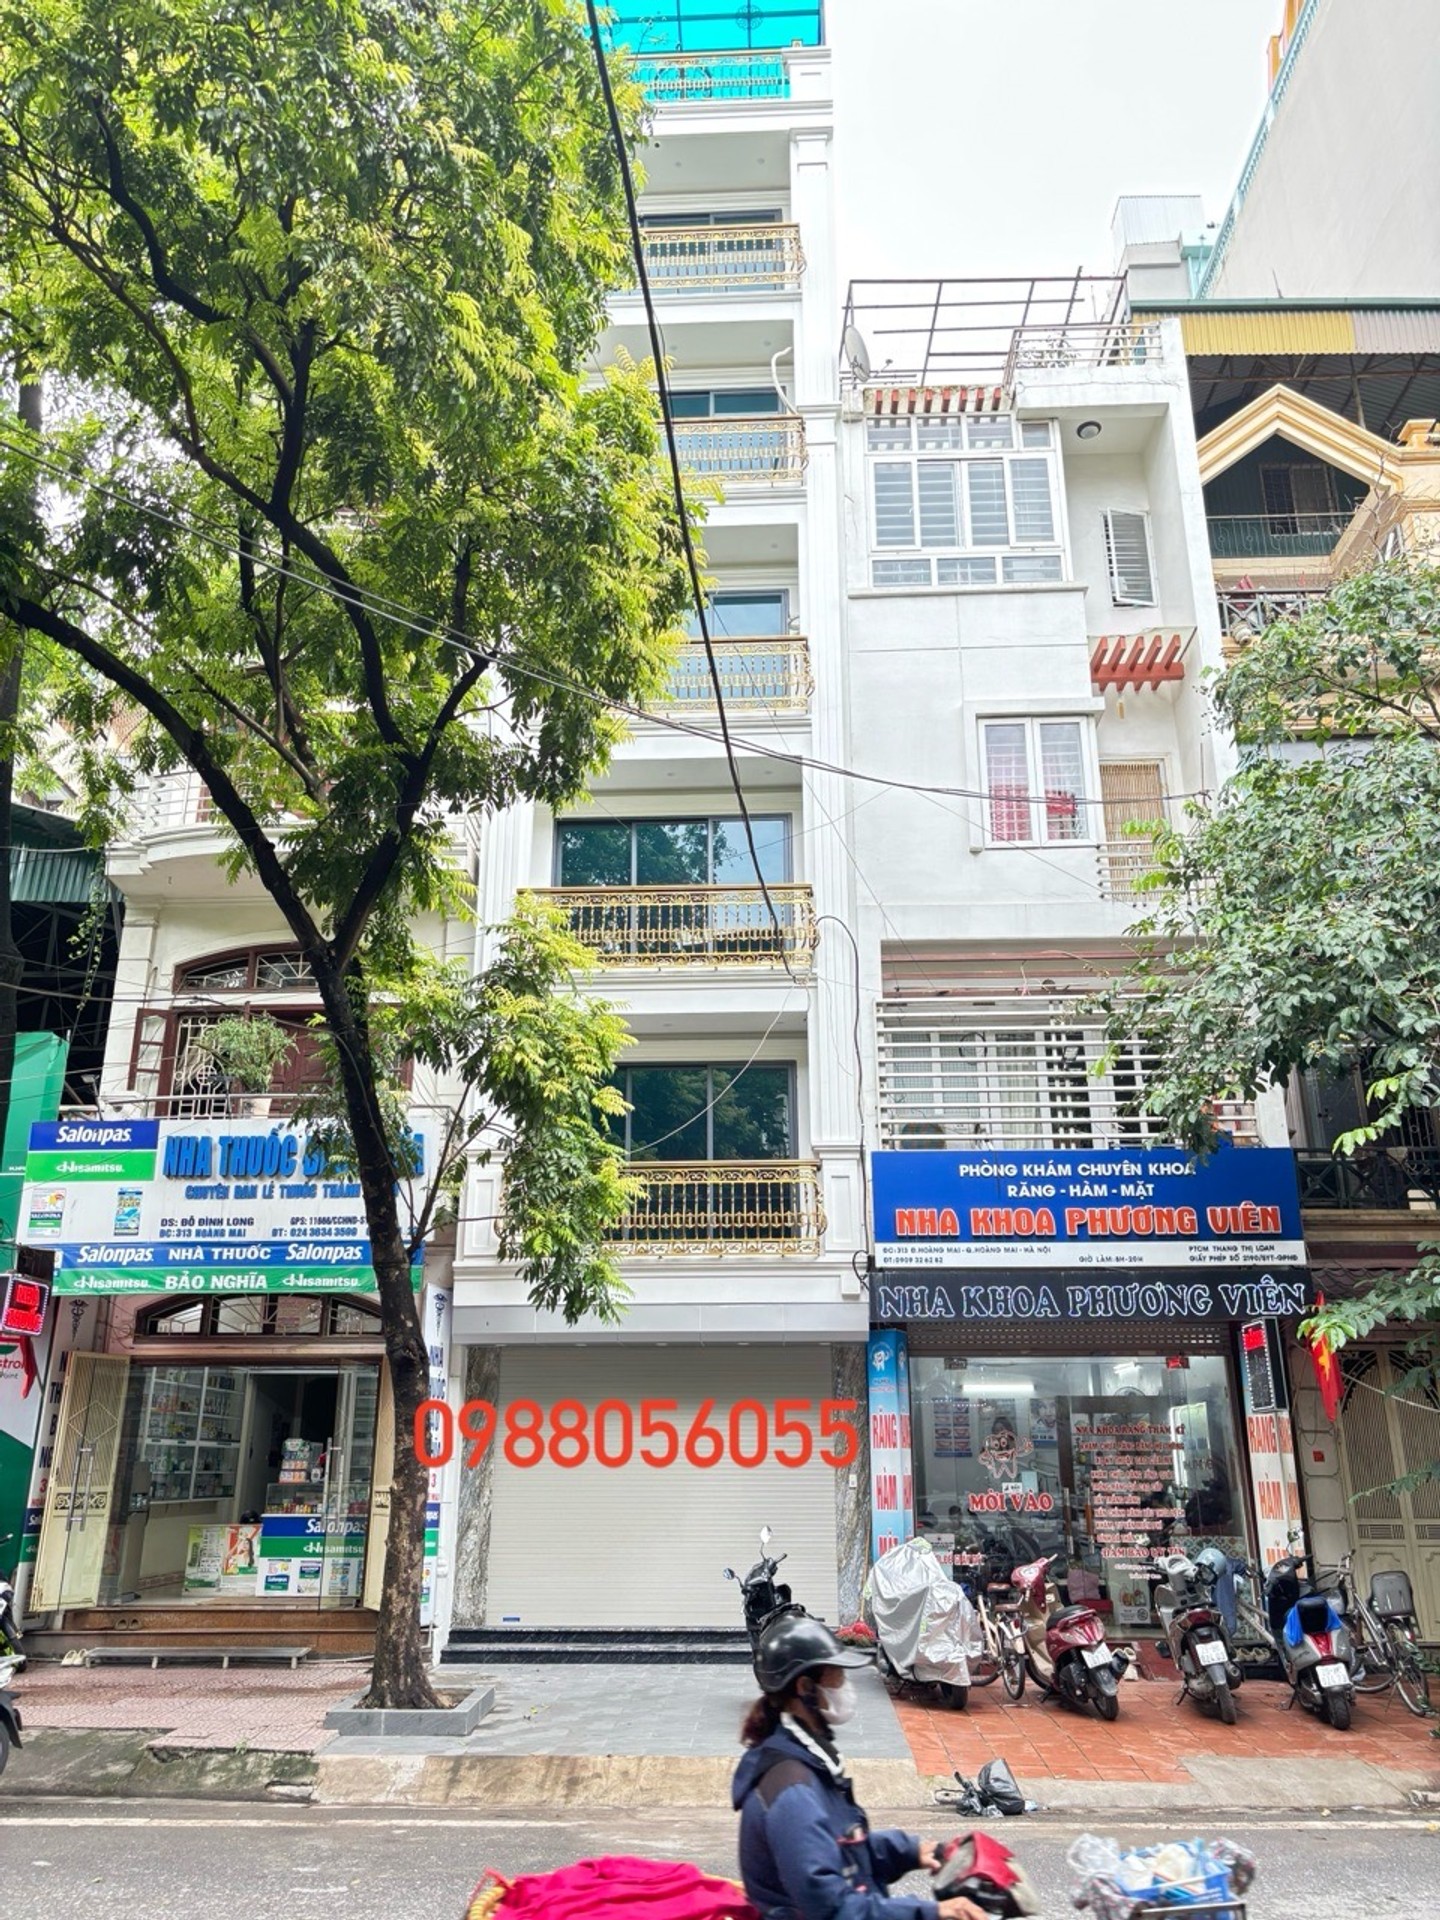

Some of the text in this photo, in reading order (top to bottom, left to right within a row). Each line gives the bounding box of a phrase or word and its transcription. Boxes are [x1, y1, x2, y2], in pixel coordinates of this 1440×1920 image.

[56, 1126, 132, 1145] Salonpas
[219, 1123, 298, 1178] THUỐC
[959, 1159, 1196, 1177] PHÒNG KHÁM CHUYÊN KHOA
[1006, 1181, 1056, 1197] RĂNG
[1069, 1180, 1108, 1197] HÀM
[1120, 1180, 1155, 1200] MẶT
[161, 1217, 178, 1227] DS:
[198, 1216, 224, 1227] ĐÌNH
[226, 1217, 254, 1227] LONG
[896, 1200, 1282, 1236] NHA KHOA PHƯƠNG VIÊN
[228, 1228, 246, 1238] MAI
[77, 1244, 363, 1265] Salonpas NHÀ THUỐC Salonpas
[165, 1271, 205, 1289] BẢO
[210, 1272, 267, 1289] NGHĨA
[879, 1273, 1306, 1318] NHA KHOA PHƯƠNG VIÊN
[875, 1466, 898, 1510] HÀM
[1258, 1472, 1284, 1520] HÀM
[968, 1488, 1053, 1512] MỜI VÀO
